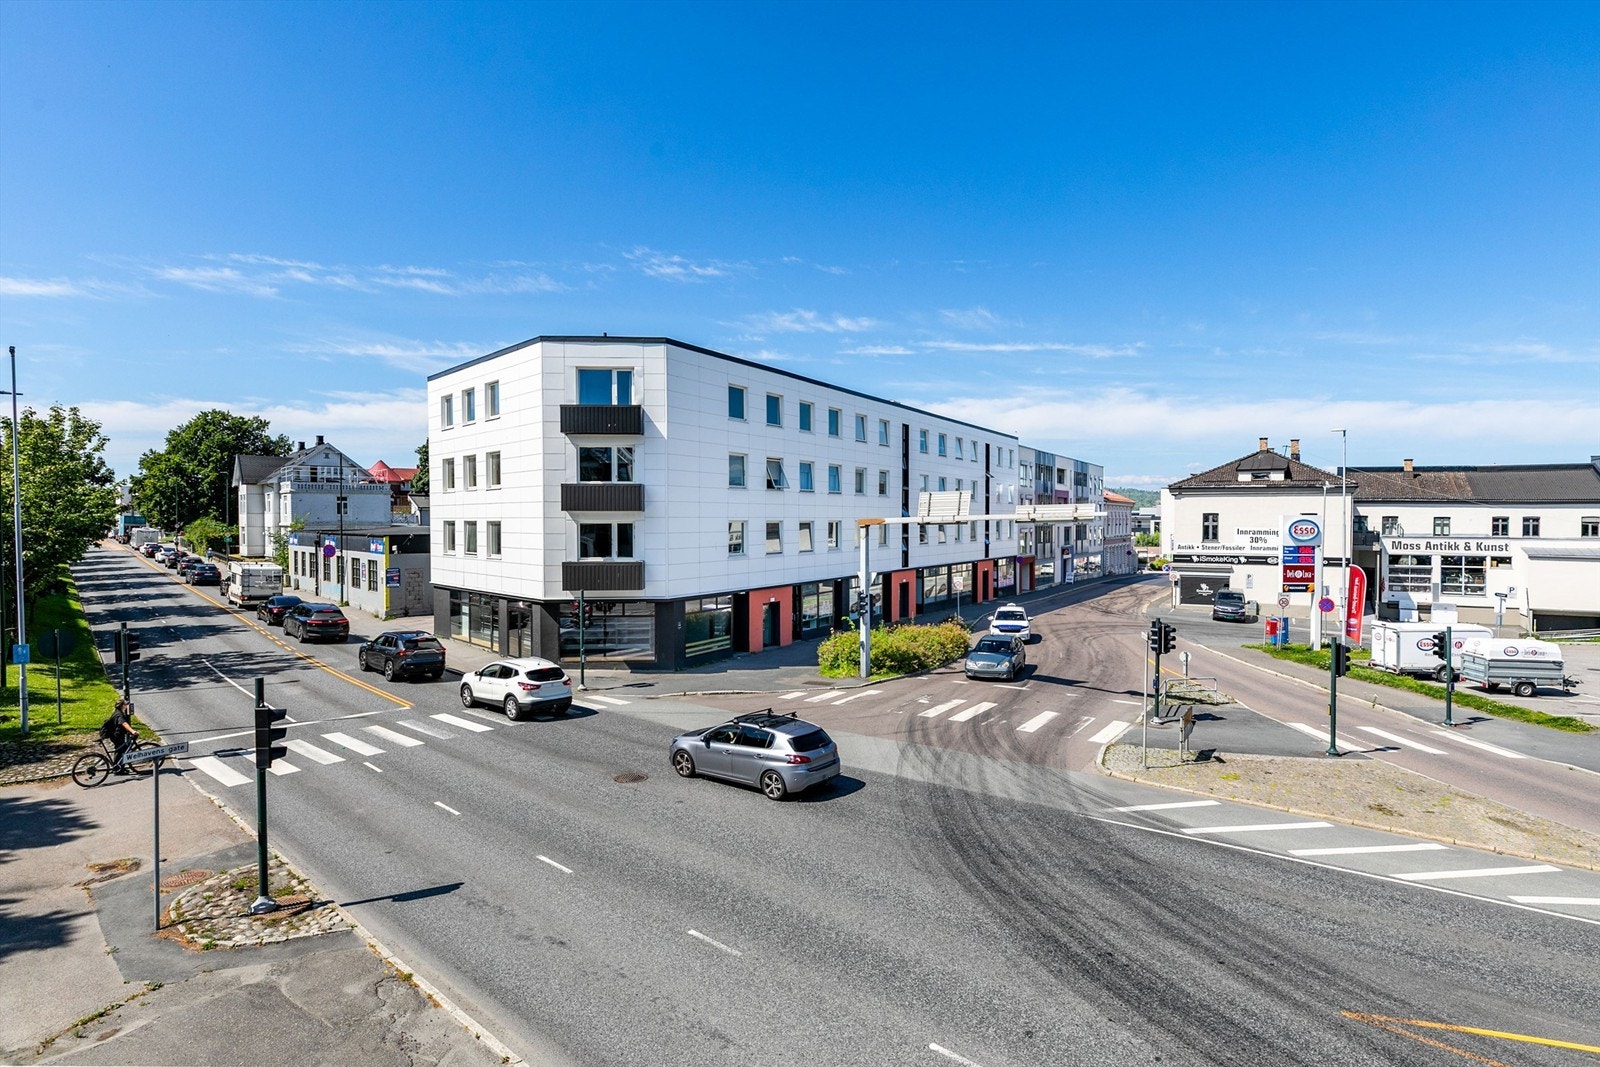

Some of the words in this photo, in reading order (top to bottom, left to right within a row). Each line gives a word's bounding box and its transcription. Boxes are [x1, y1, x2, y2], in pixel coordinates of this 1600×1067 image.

[1237, 528, 1279, 537] Innramming
[1293, 525, 1316, 535] Esso
[1249, 536, 1268, 544] 30%
[1391, 540, 1421, 550] Moss
[1425, 541, 1460, 551] Antikk
[1463, 541, 1472, 551] &
[1476, 541, 1509, 552] Kunst
[126, 748, 165, 761] Welhavens
[168, 744, 185, 754] gate
